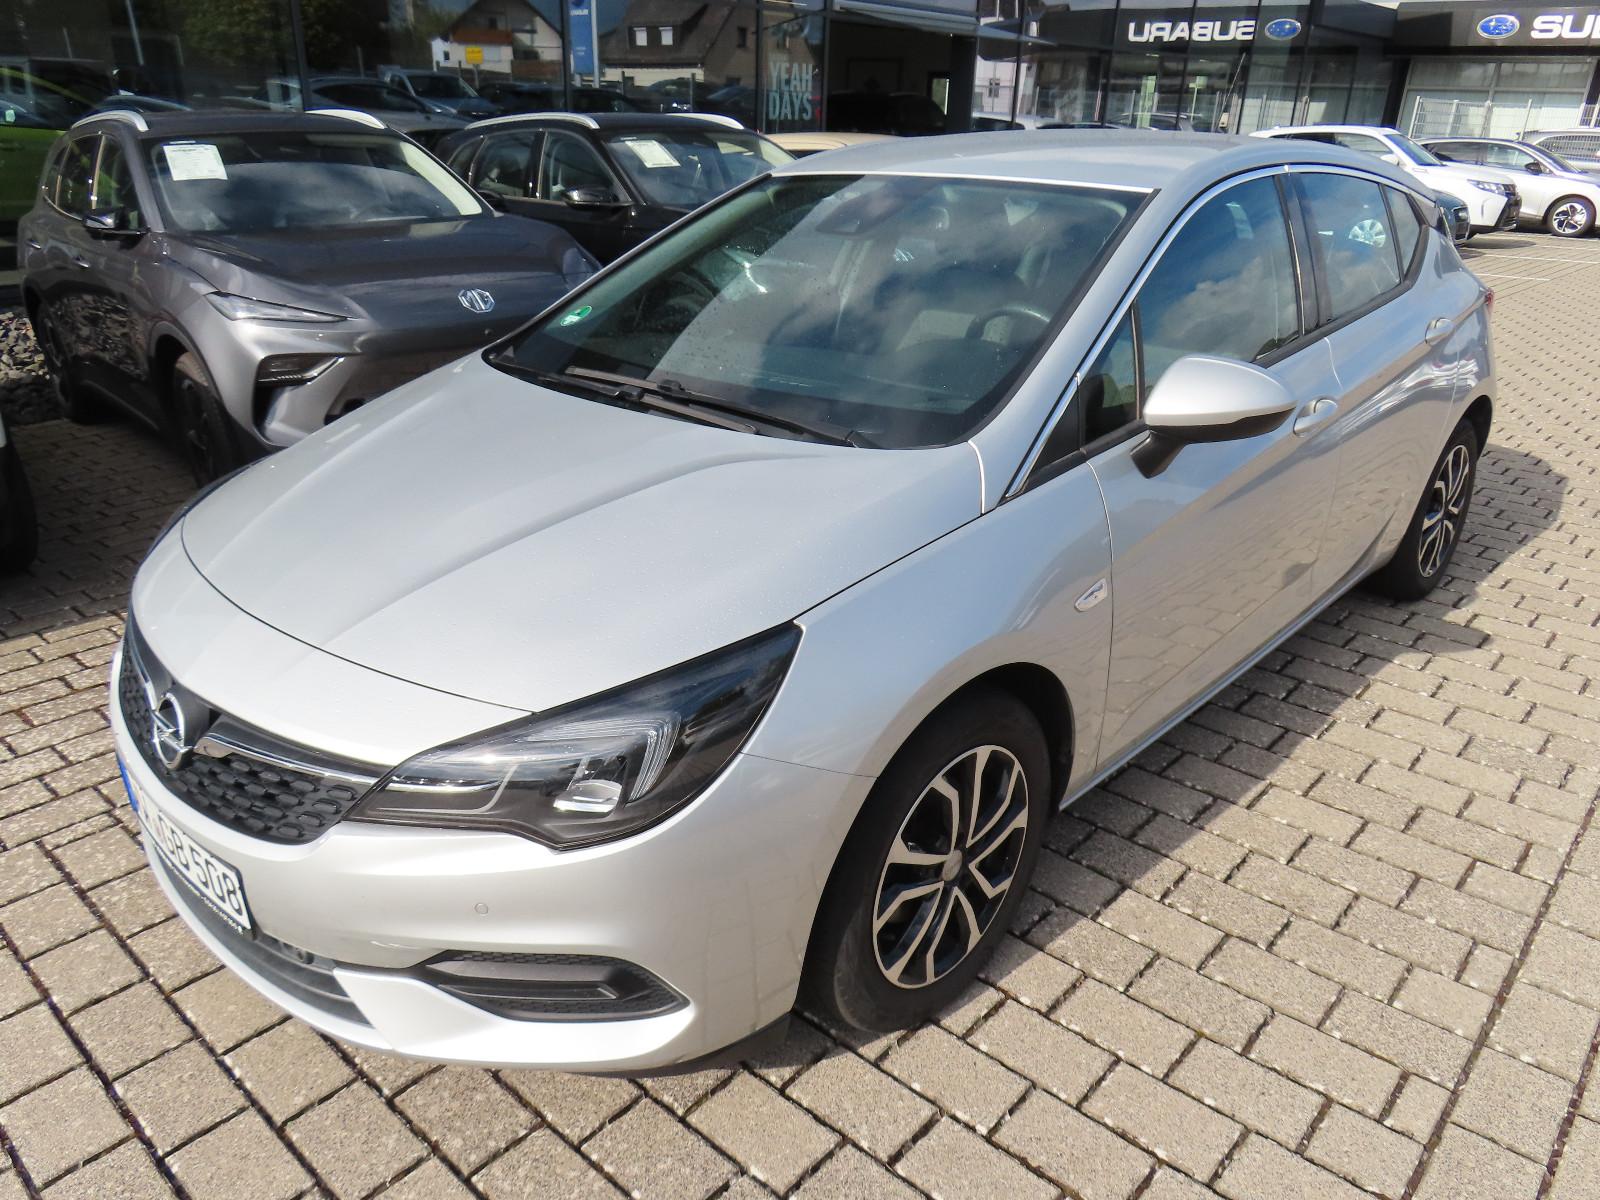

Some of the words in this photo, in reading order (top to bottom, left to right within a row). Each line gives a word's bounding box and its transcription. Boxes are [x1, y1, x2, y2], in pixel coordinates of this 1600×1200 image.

[769, 62, 813, 92] YEAH
[768, 91, 813, 121] DAYS
[188, 843, 244, 917] 508
